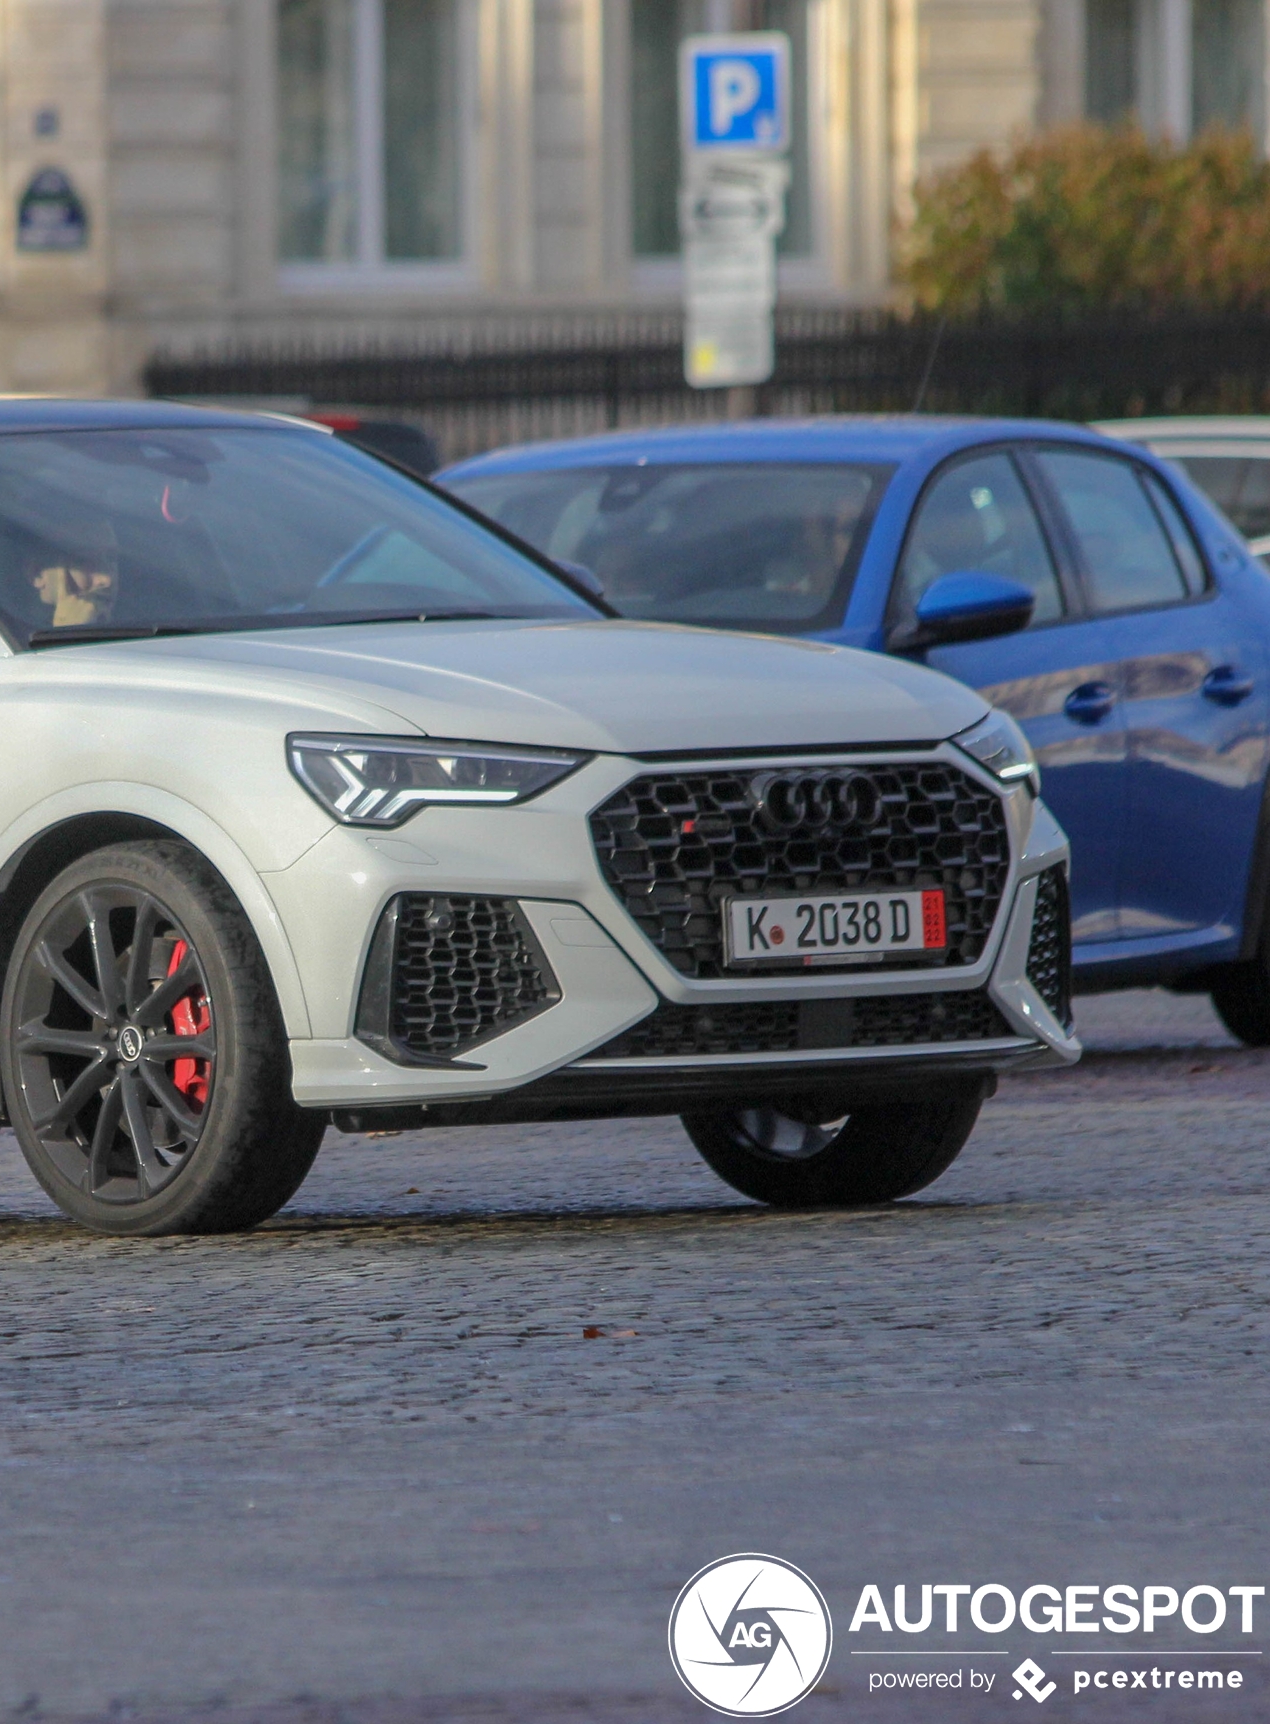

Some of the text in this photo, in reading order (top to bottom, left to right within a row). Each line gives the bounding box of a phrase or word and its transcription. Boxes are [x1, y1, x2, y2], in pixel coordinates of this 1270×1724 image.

[708, 58, 761, 137] P
[747, 899, 910, 951] K 2038 D
[926, 928, 940, 942] 22
